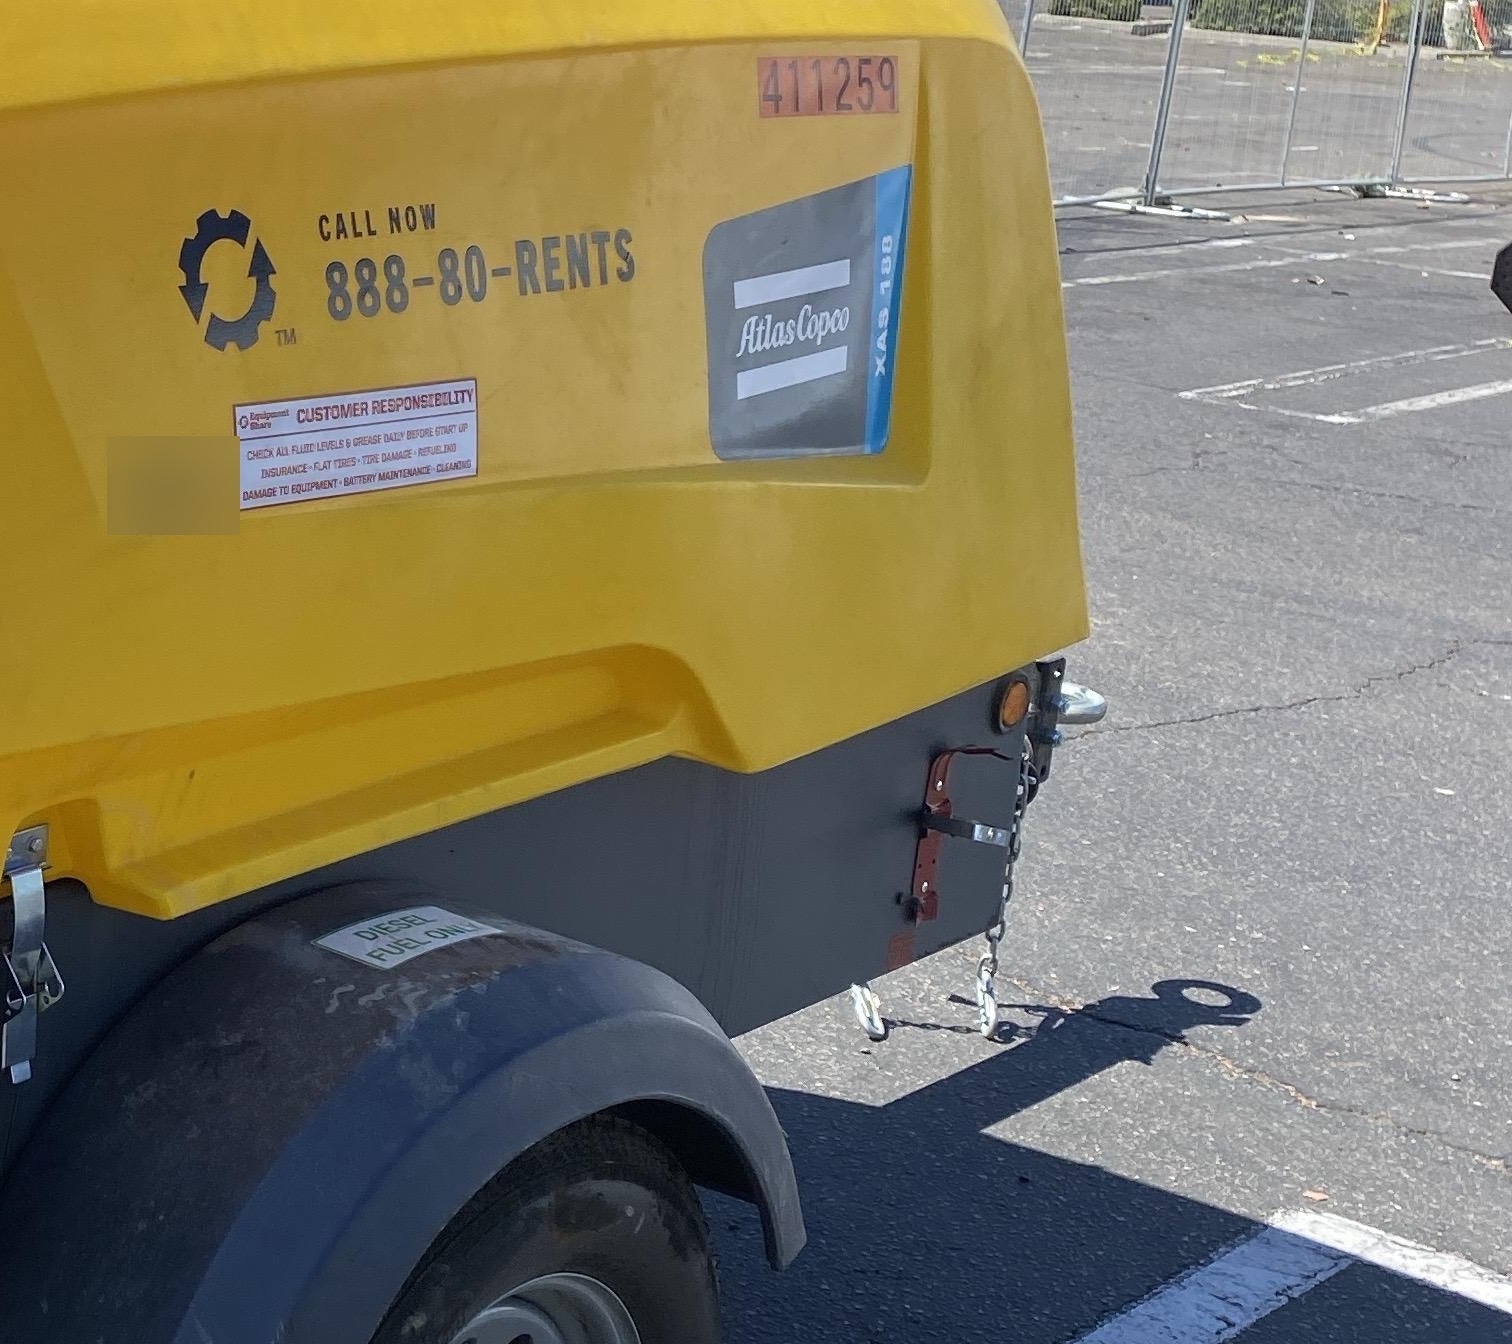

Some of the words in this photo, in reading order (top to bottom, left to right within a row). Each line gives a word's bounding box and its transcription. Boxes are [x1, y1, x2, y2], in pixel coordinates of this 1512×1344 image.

[763, 57, 896, 113] 411259
[319, 210, 377, 242] CALL
[388, 203, 437, 234] NOW
[325, 228, 636, 321] 888-80-RENTS
[296, 401, 368, 423] CUSTOMER
[371, 388, 474, 415] RESPONSIBILITY
[247, 448, 274, 460] CHECK
[276, 446, 288, 457] ALL
[291, 443, 314, 454] FLUID
[317, 439, 345, 451] LEVELS
[353, 436, 382, 447] GREASE
[384, 431, 406, 443] DAILY
[407, 427, 434, 440] BEFORE
[435, 424, 457, 436] START
[458, 422, 468, 433] UP
[242, 488, 277, 501] DAMAGE
[279, 486, 289, 496] TO
[291, 478, 338, 494] EQUIPMENT
[343, 474, 377, 487] BATTERY
[378, 464, 432, 481] MAINTENANCE
[436, 459, 472, 473] CLEANING
[261, 464, 308, 479] INSURANCE
[313, 460, 331, 471] FLAT
[334, 457, 356, 469] TIRES
[382, 449, 412, 462] DAMAGE
[354, 914, 438, 941] DIESEL
[365, 937, 432, 962] FUEL
[429, 921, 481, 940] ONLY
